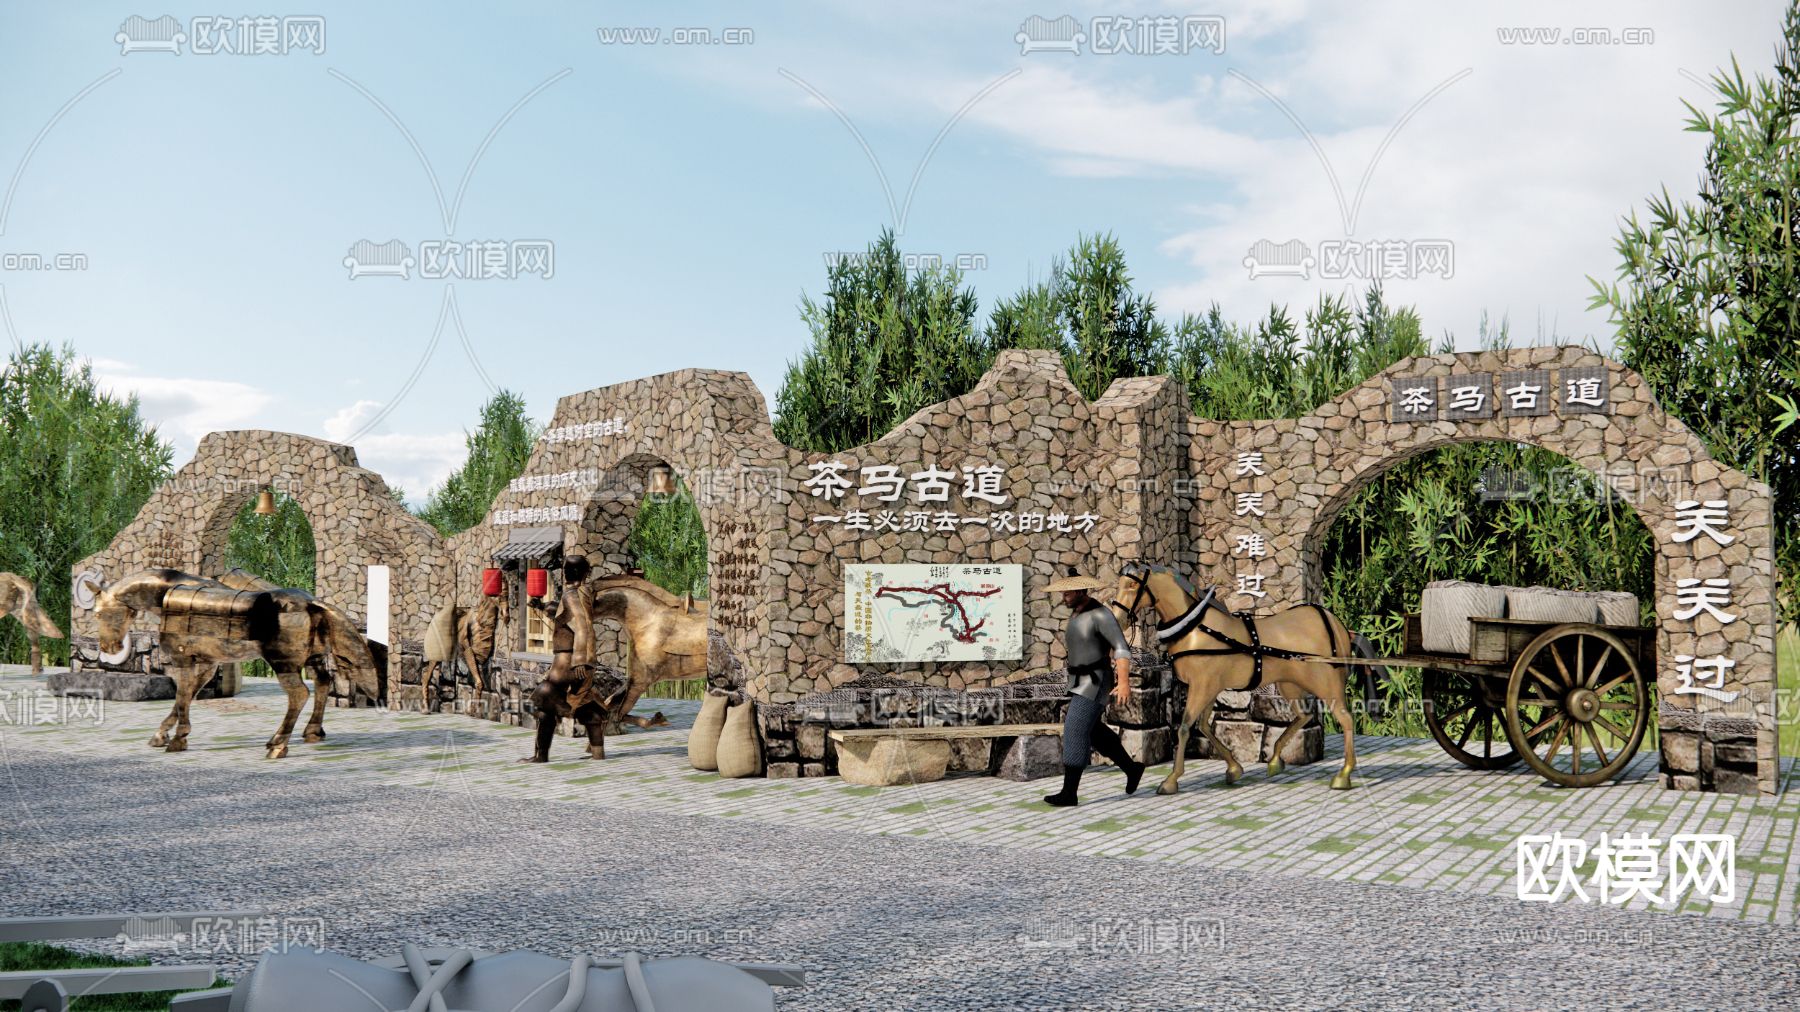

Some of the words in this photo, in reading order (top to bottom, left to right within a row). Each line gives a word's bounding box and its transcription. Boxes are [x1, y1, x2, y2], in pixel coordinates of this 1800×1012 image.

[1399, 377, 1605, 415] 茶马古道
[804, 461, 1007, 505] 茶马古道
[812, 509, 1100, 534] 一生必须去一次的地方
[1235, 452, 1267, 598] 关关难过
[962, 567, 1003, 576] 茶马古道
[1671, 500, 1740, 703] 关关过
